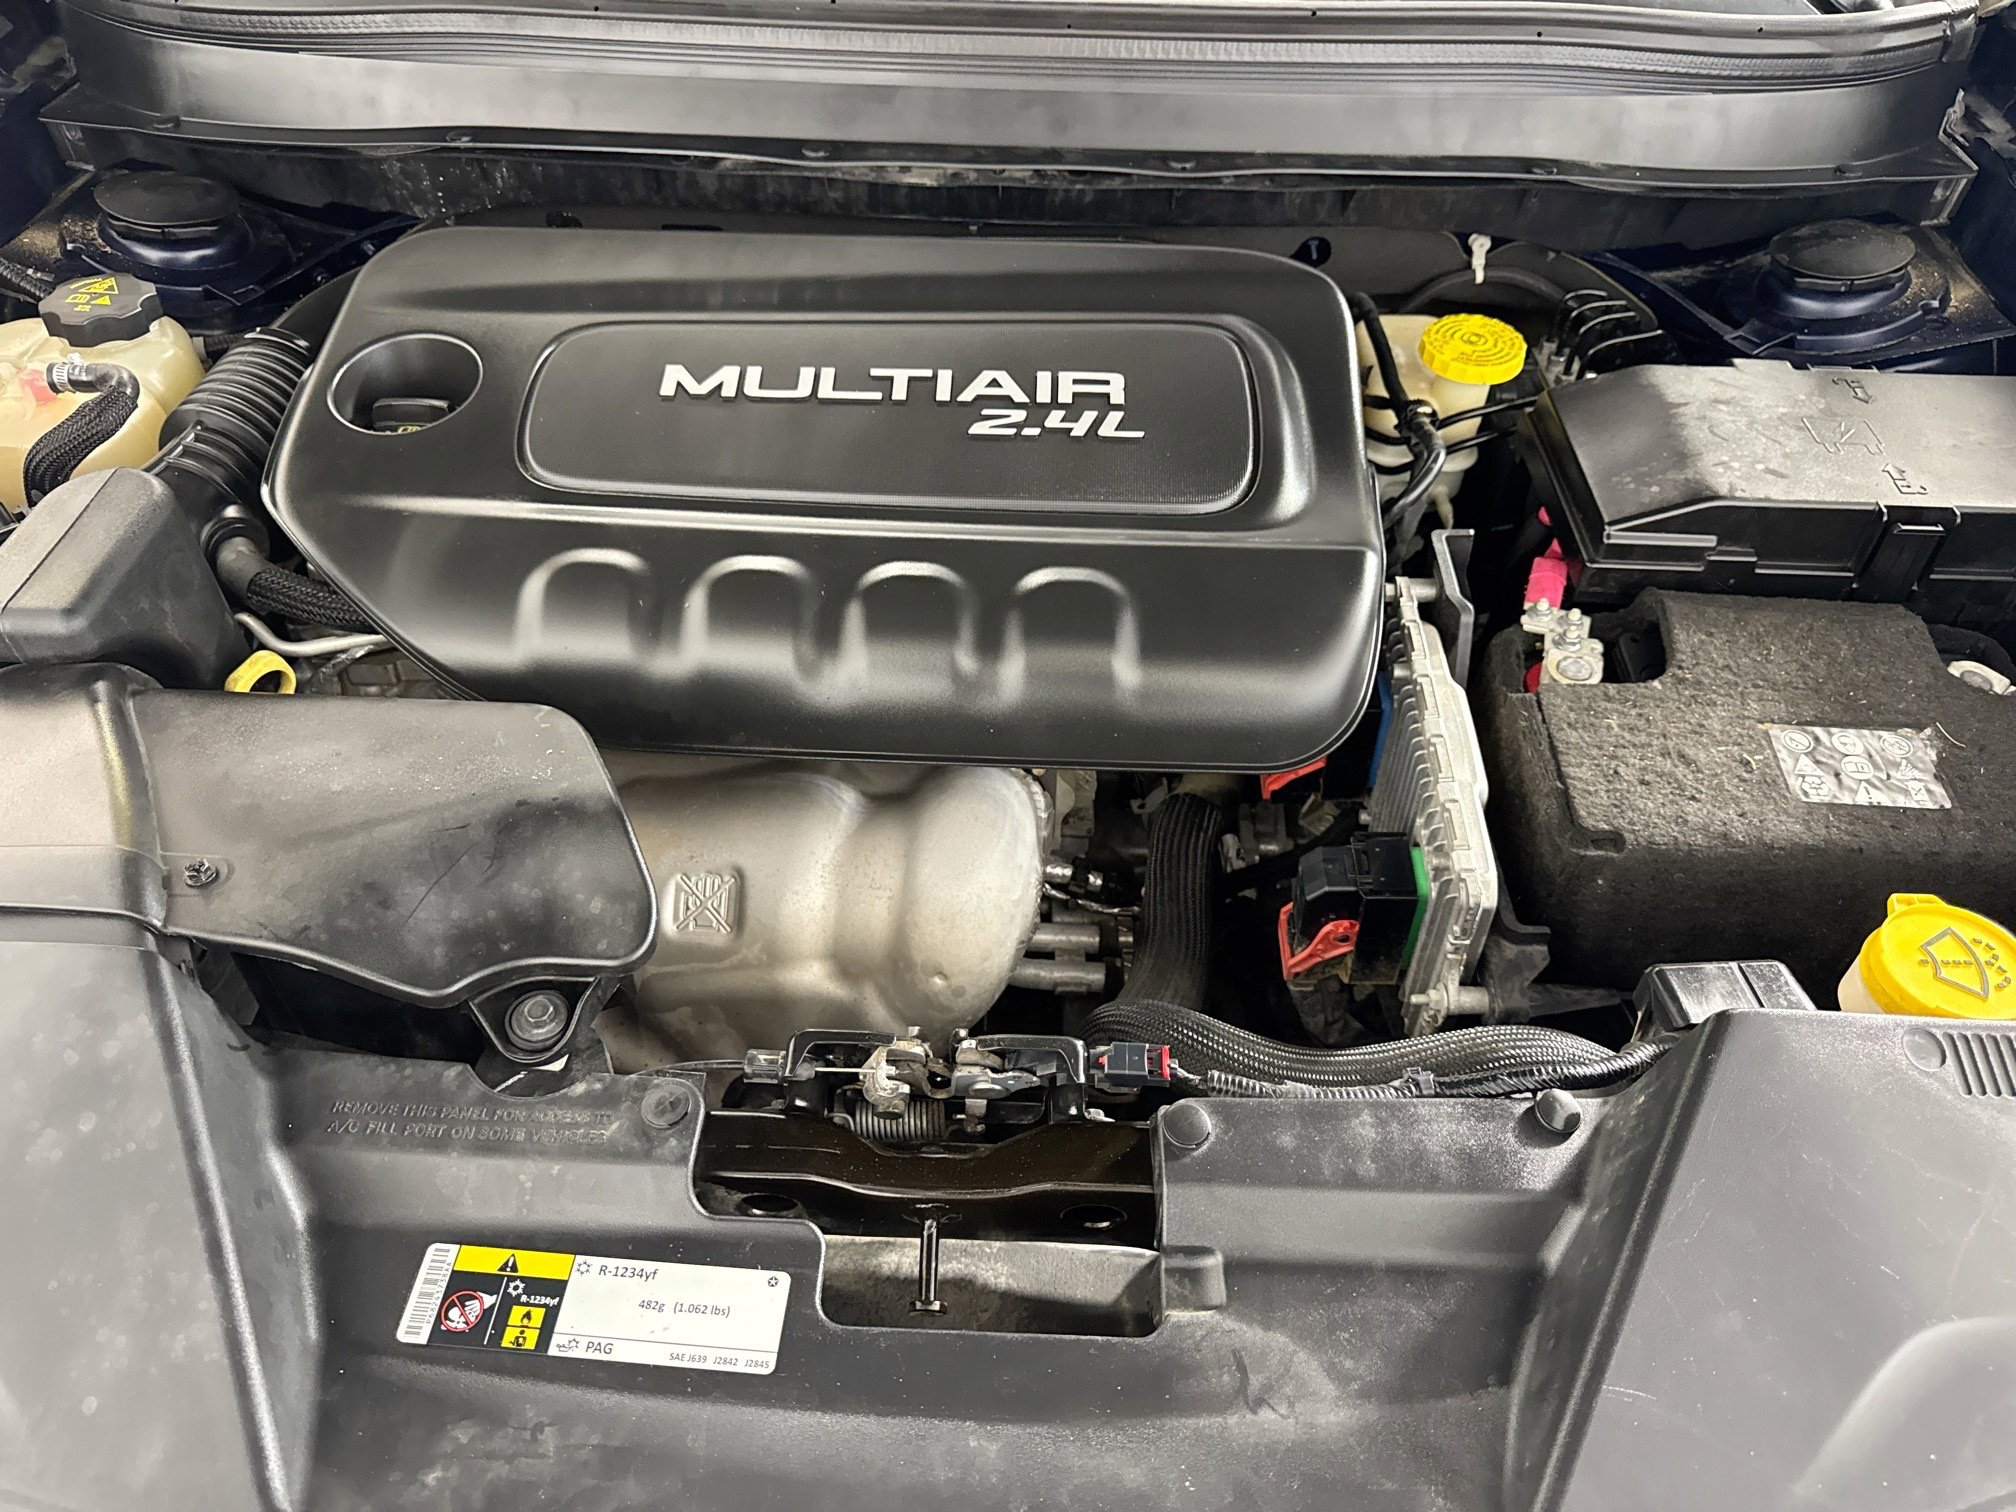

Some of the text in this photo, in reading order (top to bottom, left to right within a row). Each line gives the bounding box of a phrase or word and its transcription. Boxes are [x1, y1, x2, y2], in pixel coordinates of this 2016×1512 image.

[658, 363, 1126, 405] MULTIAIR
[967, 408, 1146, 438] 2.4L
[332, 1100, 400, 1117] REMOVE
[402, 1103, 438, 1118] THIS
[440, 1106, 489, 1121] PANEL
[365, 1120, 398, 1136] FILL
[402, 1122, 448, 1138] PORT
[451, 1125, 476, 1140] ON
[478, 1126, 526, 1142] SOME
[598, 1264, 659, 1282] R-1234yf
[520, 1294, 560, 1307] R-1234yf
[638, 1299, 731, 1318] 482g (1.062 lbs)
[585, 1341, 614, 1355] PAG
[669, 1352, 770, 1369] SAE J639 J2842 J2845
